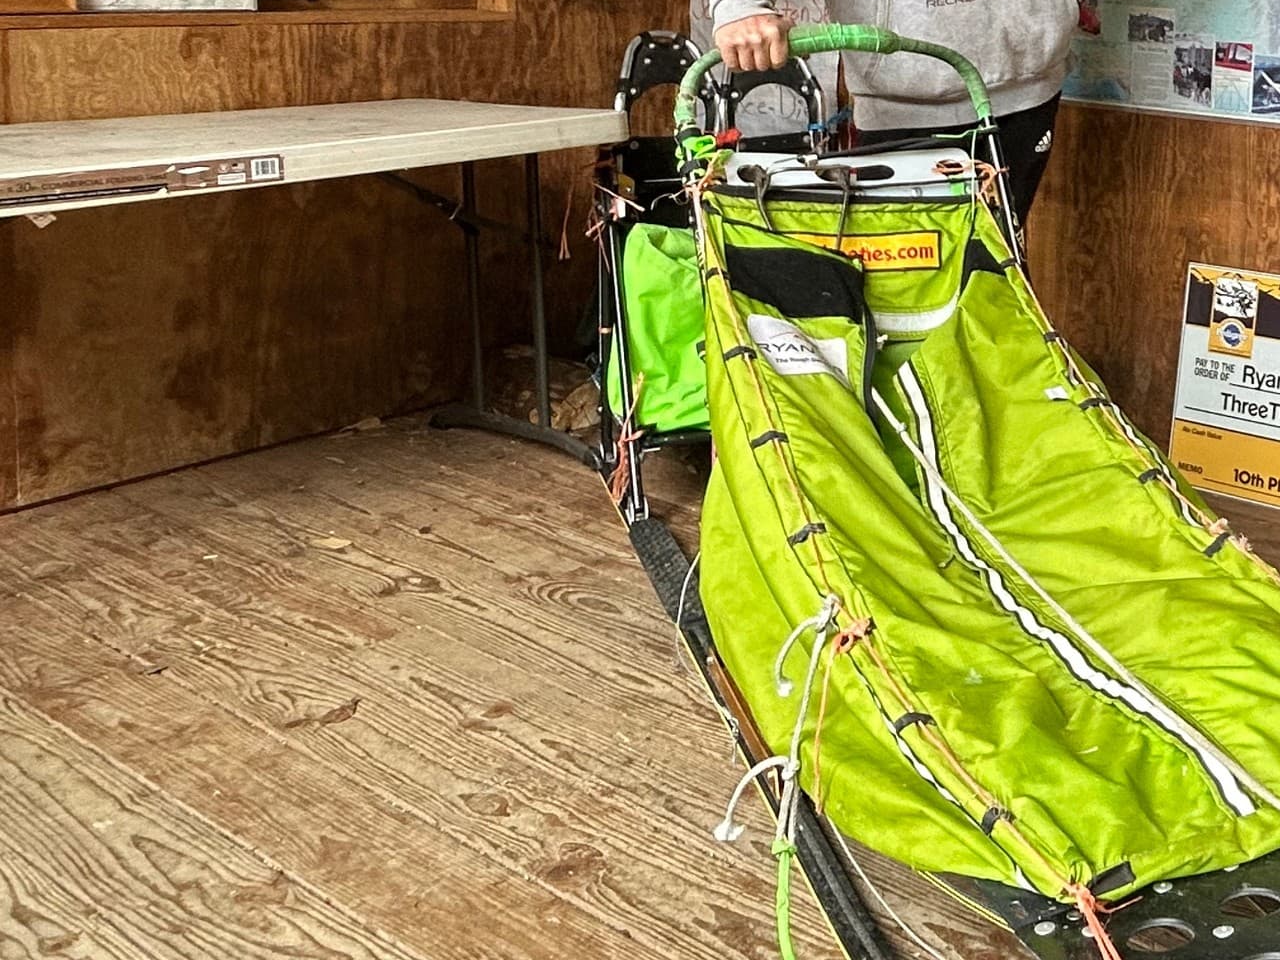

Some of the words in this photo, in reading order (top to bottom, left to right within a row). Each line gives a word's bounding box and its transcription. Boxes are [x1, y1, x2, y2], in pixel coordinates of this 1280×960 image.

[1195, 357, 1208, 368] PAY
[1210, 360, 1220, 370] TO
[1222, 362, 1236, 374] THE
[1194, 368, 1219, 381] ORDER
[1220, 372, 1231, 382] OF
[1178, 461, 1203, 474] MEMO
[1232, 468, 1264, 489] 10th
